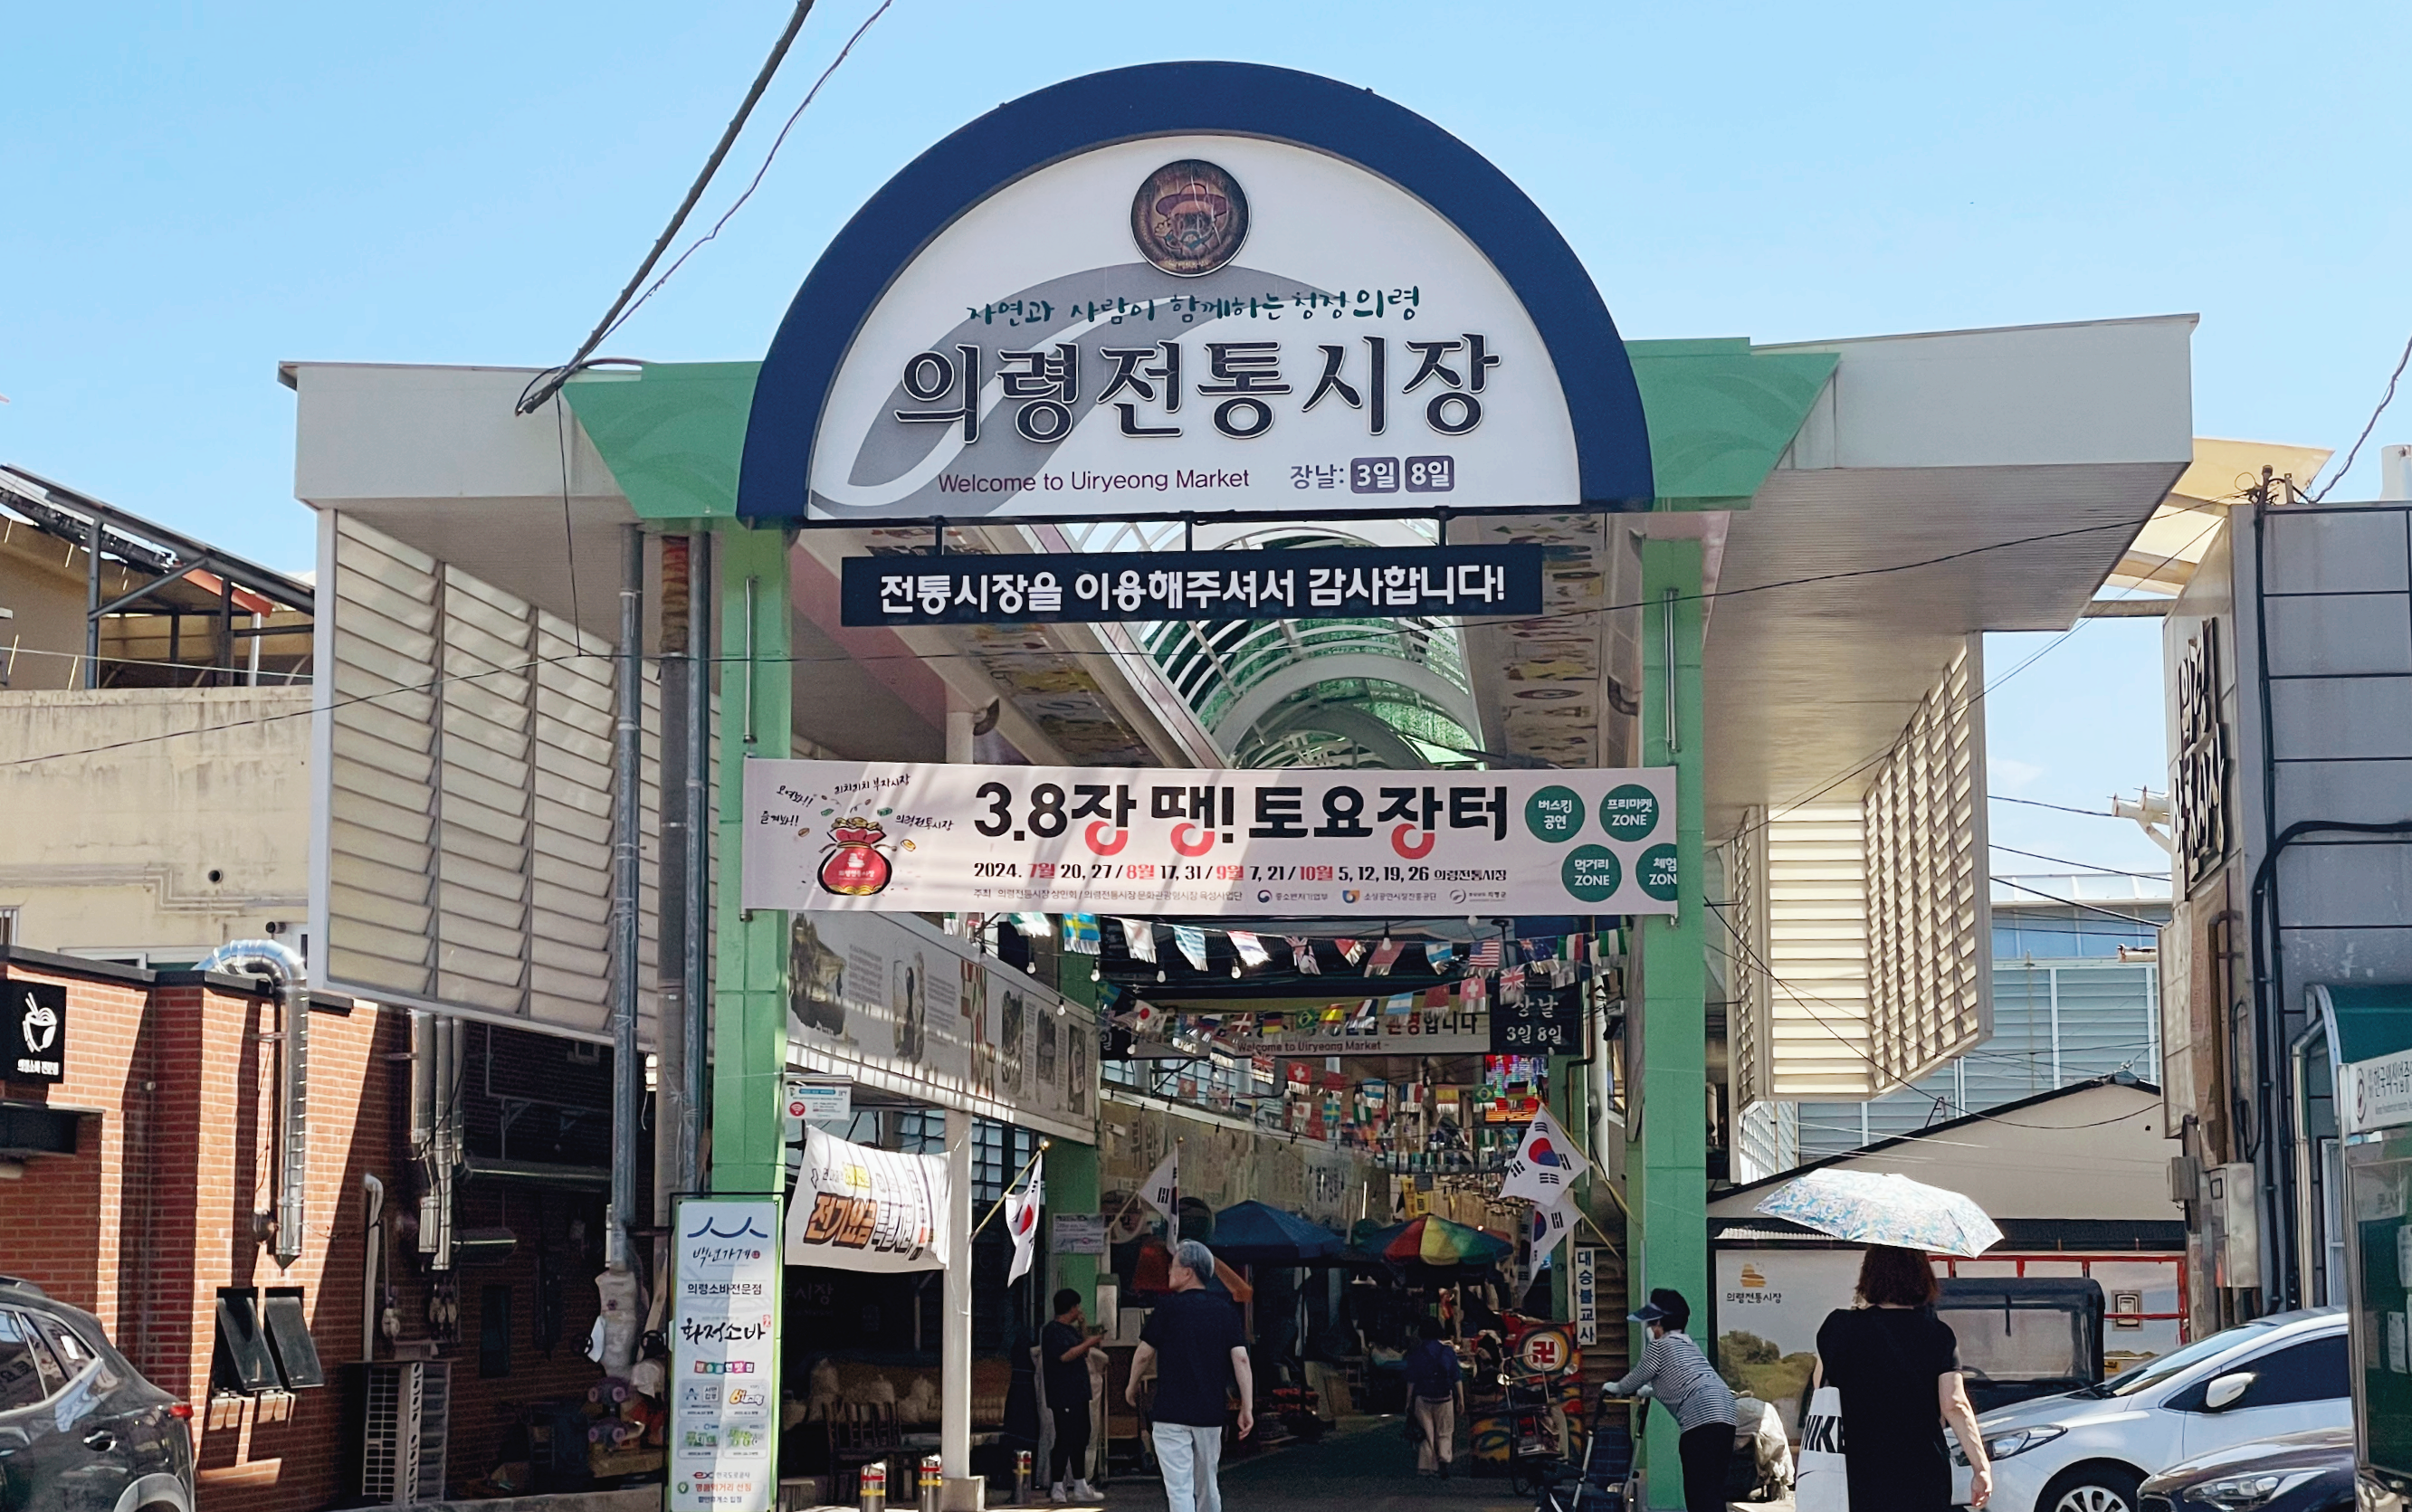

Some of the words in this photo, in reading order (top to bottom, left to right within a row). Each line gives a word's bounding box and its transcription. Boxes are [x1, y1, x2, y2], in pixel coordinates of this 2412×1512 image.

[967, 300, 1054, 327] 자연과
[1070, 297, 1155, 325] 사람이
[1171, 292, 1284, 324] 함께하는
[892, 332, 1502, 444] 의령전통시장
[938, 472, 1037, 495] Welcome
[1044, 474, 1063, 491] to
[1072, 470, 1168, 497] Uiryeong
[1176, 468, 1249, 490] Market
[1290, 462, 1345, 490] 장날:
[1356, 460, 1398, 489] 3일
[1410, 459, 1453, 489] 8일
[879, 572, 1063, 615] 전통시장을
[1074, 567, 1296, 612] 이용해주셔서
[1309, 563, 1506, 608] 감사합니다!
[1538, 799, 1573, 814] 버스킹
[1606, 798, 1654, 813] 프리마켓
[973, 781, 1138, 857] 3.8장
[1150, 785, 1235, 858] 땡!
[1248, 785, 1508, 861] 토요장터
[1543, 815, 1568, 831] 공연
[1611, 814, 1648, 826] ZONE
[973, 862, 1022, 880] 2024.
[1029, 862, 1055, 880] 7월
[1060, 863, 1085, 881] 20,
[1091, 863, 1111, 880] 27
[1126, 863, 1155, 881] 8월
[1159, 864, 1179, 882] 17,
[1185, 865, 1202, 880] 31
[1216, 865, 1244, 881] 9월
[1249, 866, 1263, 883] 7,
[1267, 866, 1284, 881] 21
[1300, 865, 1334, 881] 10월
[1338, 866, 1354, 884] 5,
[1359, 866, 1380, 883] 12,
[1384, 866, 1405, 883] 19,
[1407, 866, 1430, 882] 26
[1434, 869, 1507, 882] 의령전통시장
[1574, 859, 1609, 874] 먹거리
[1653, 858, 1677, 872] 체험
[1574, 875, 1610, 887] ZONE
[997, 888, 1050, 901] 의령전통시장
[1084, 889, 1136, 901] 의령전통시장
[1506, 1023, 1532, 1044] 3일
[1538, 1023, 1562, 1045] 8일
[1237, 1041, 1282, 1054] Welcome
[1284, 1041, 1296, 1052] to
[1299, 1041, 1342, 1054] Uiryeong
[1345, 1039, 1382, 1051] Market
[692, 1245, 751, 1268] 백년가게
[687, 1283, 763, 1295] 의령소바전문점
[1578, 1250, 1595, 1343] 대승불교사
[1726, 1291, 1782, 1304] 의령전통시장
[681, 1317, 767, 1346] 화정소바
